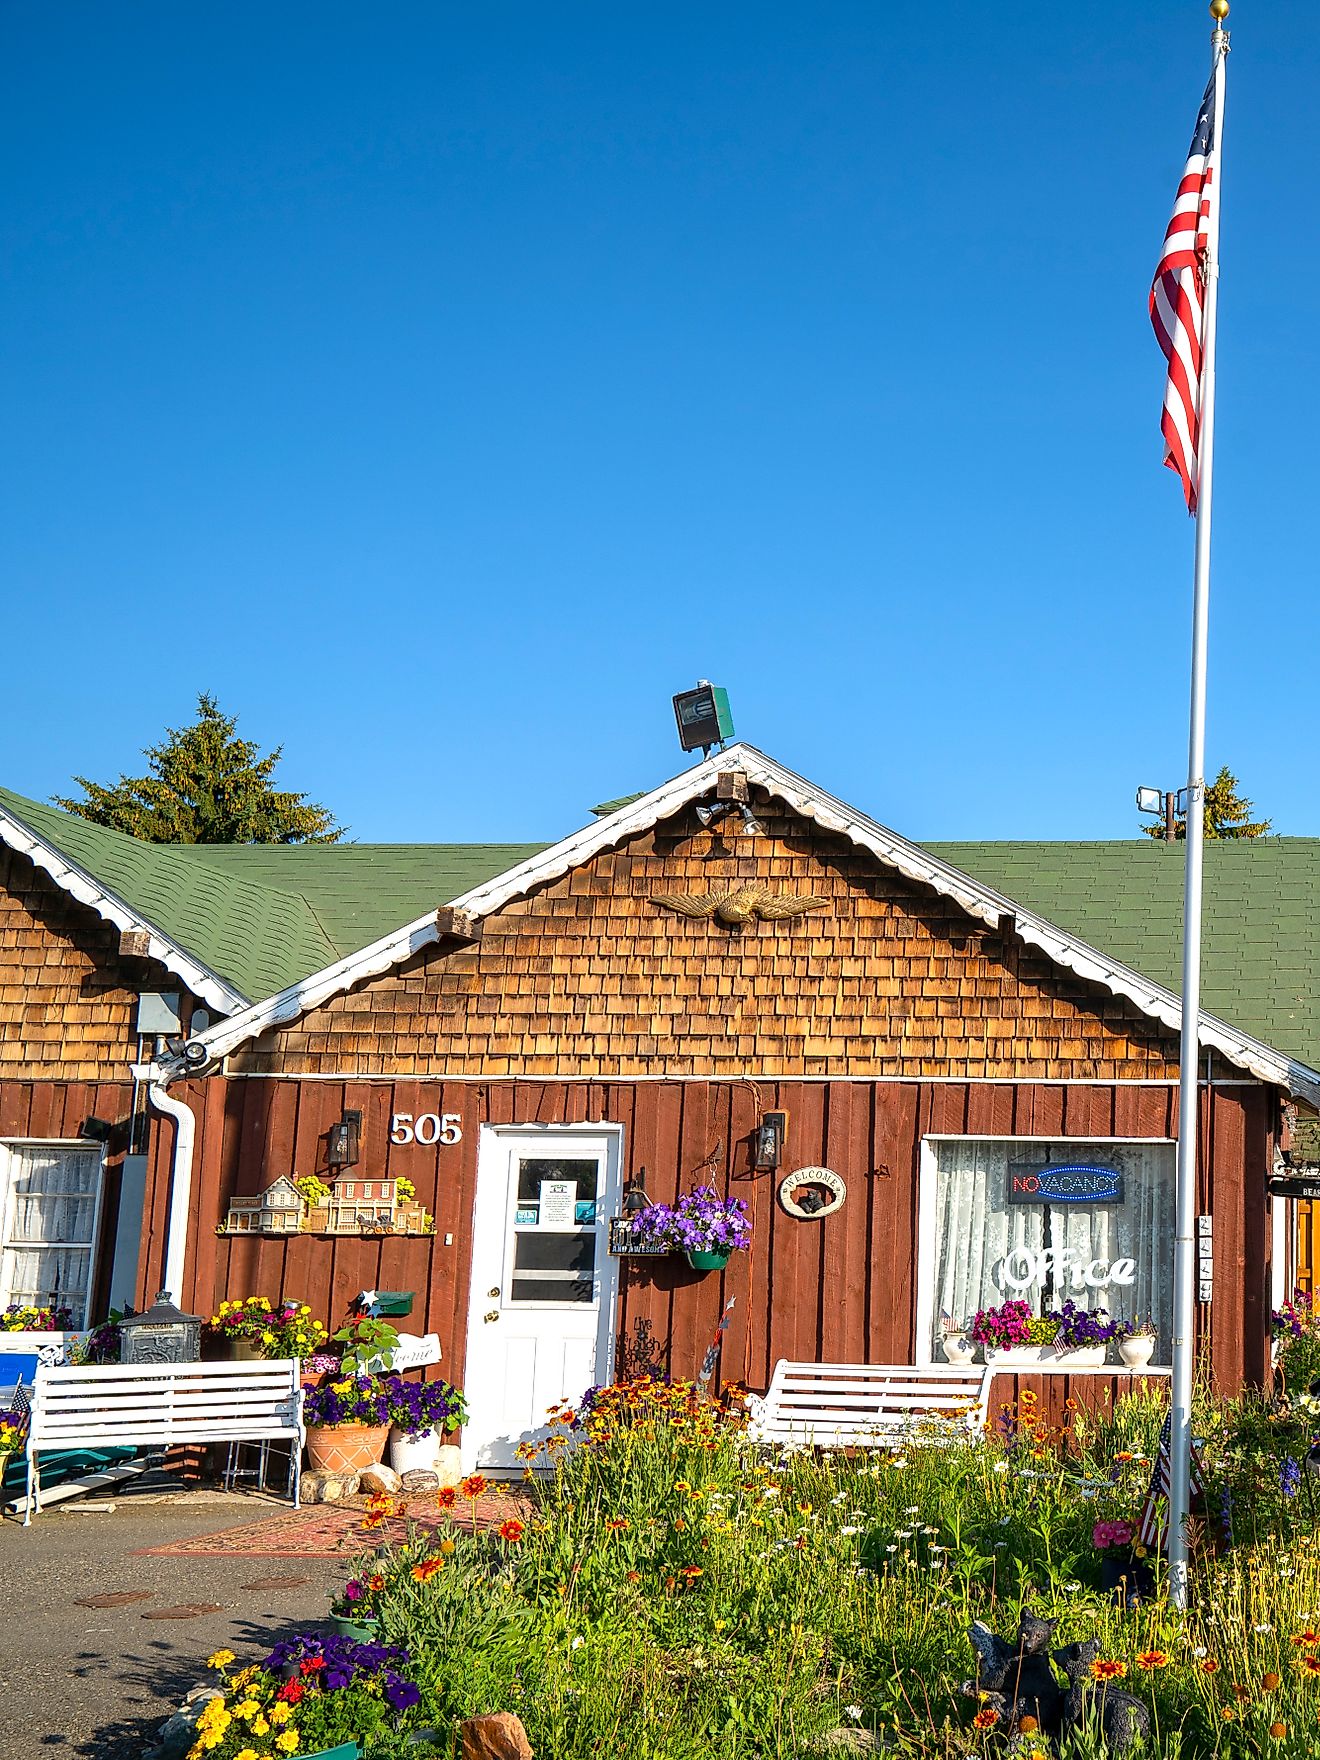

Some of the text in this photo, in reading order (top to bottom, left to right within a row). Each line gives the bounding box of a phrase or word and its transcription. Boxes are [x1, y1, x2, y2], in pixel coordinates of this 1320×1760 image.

[390, 1113, 463, 1145] 505
[785, 1169, 838, 1188] WELCOME
[1013, 1174, 1121, 1193] NO VACANCY
[1002, 1246, 1136, 1290] Office
